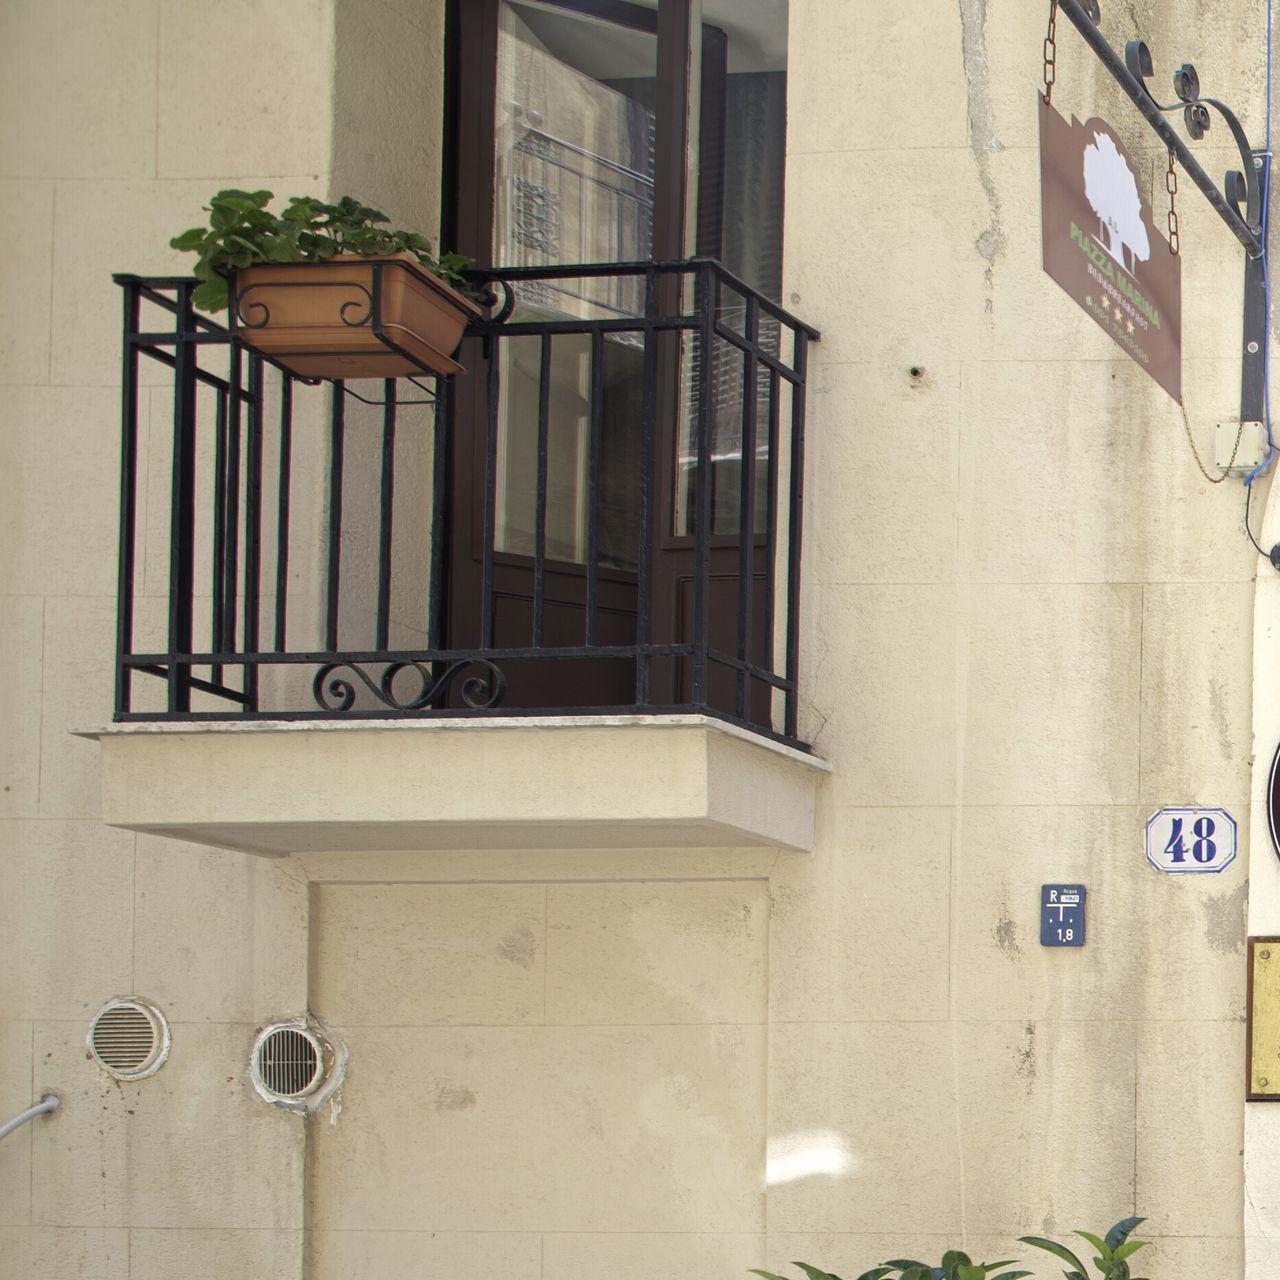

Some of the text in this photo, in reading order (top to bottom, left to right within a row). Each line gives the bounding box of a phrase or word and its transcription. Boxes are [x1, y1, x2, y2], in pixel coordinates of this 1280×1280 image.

[1070, 221, 1115, 279] PIAZZA
[1163, 816, 1217, 863] 48
[1050, 889, 1057, 902] R
